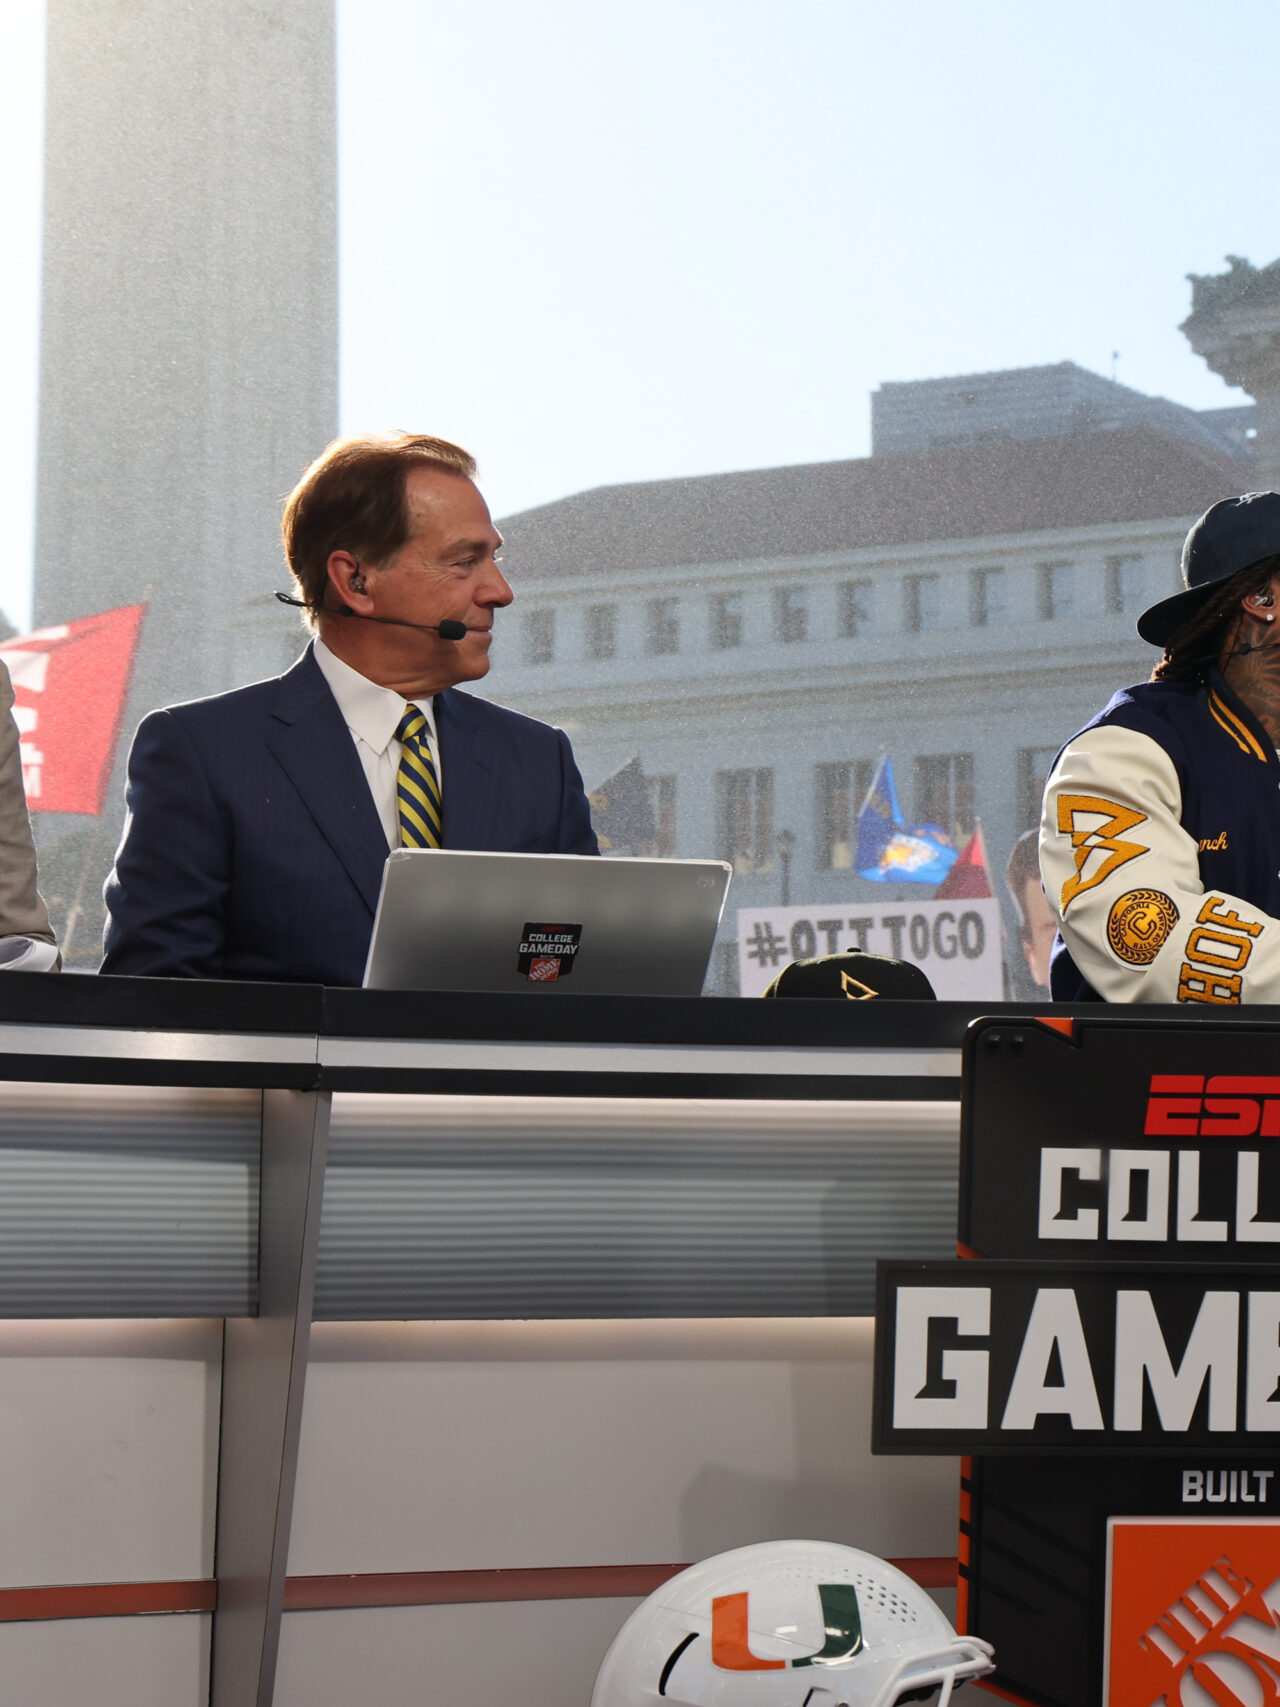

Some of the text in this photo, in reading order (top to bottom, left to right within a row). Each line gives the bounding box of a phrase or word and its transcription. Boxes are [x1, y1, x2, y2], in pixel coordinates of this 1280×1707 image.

[1119, 903, 1150, 938] CALIFORNIA
[1133, 911, 1165, 950] HALL OF FAME
[519, 943, 578, 954] GAMEDAY
[529, 934, 573, 943] COLLEGE
[1177, 896, 1265, 1005] HOF
[1182, 1470, 1275, 1503] BUILT
[1137, 1553, 1255, 1668] THE
